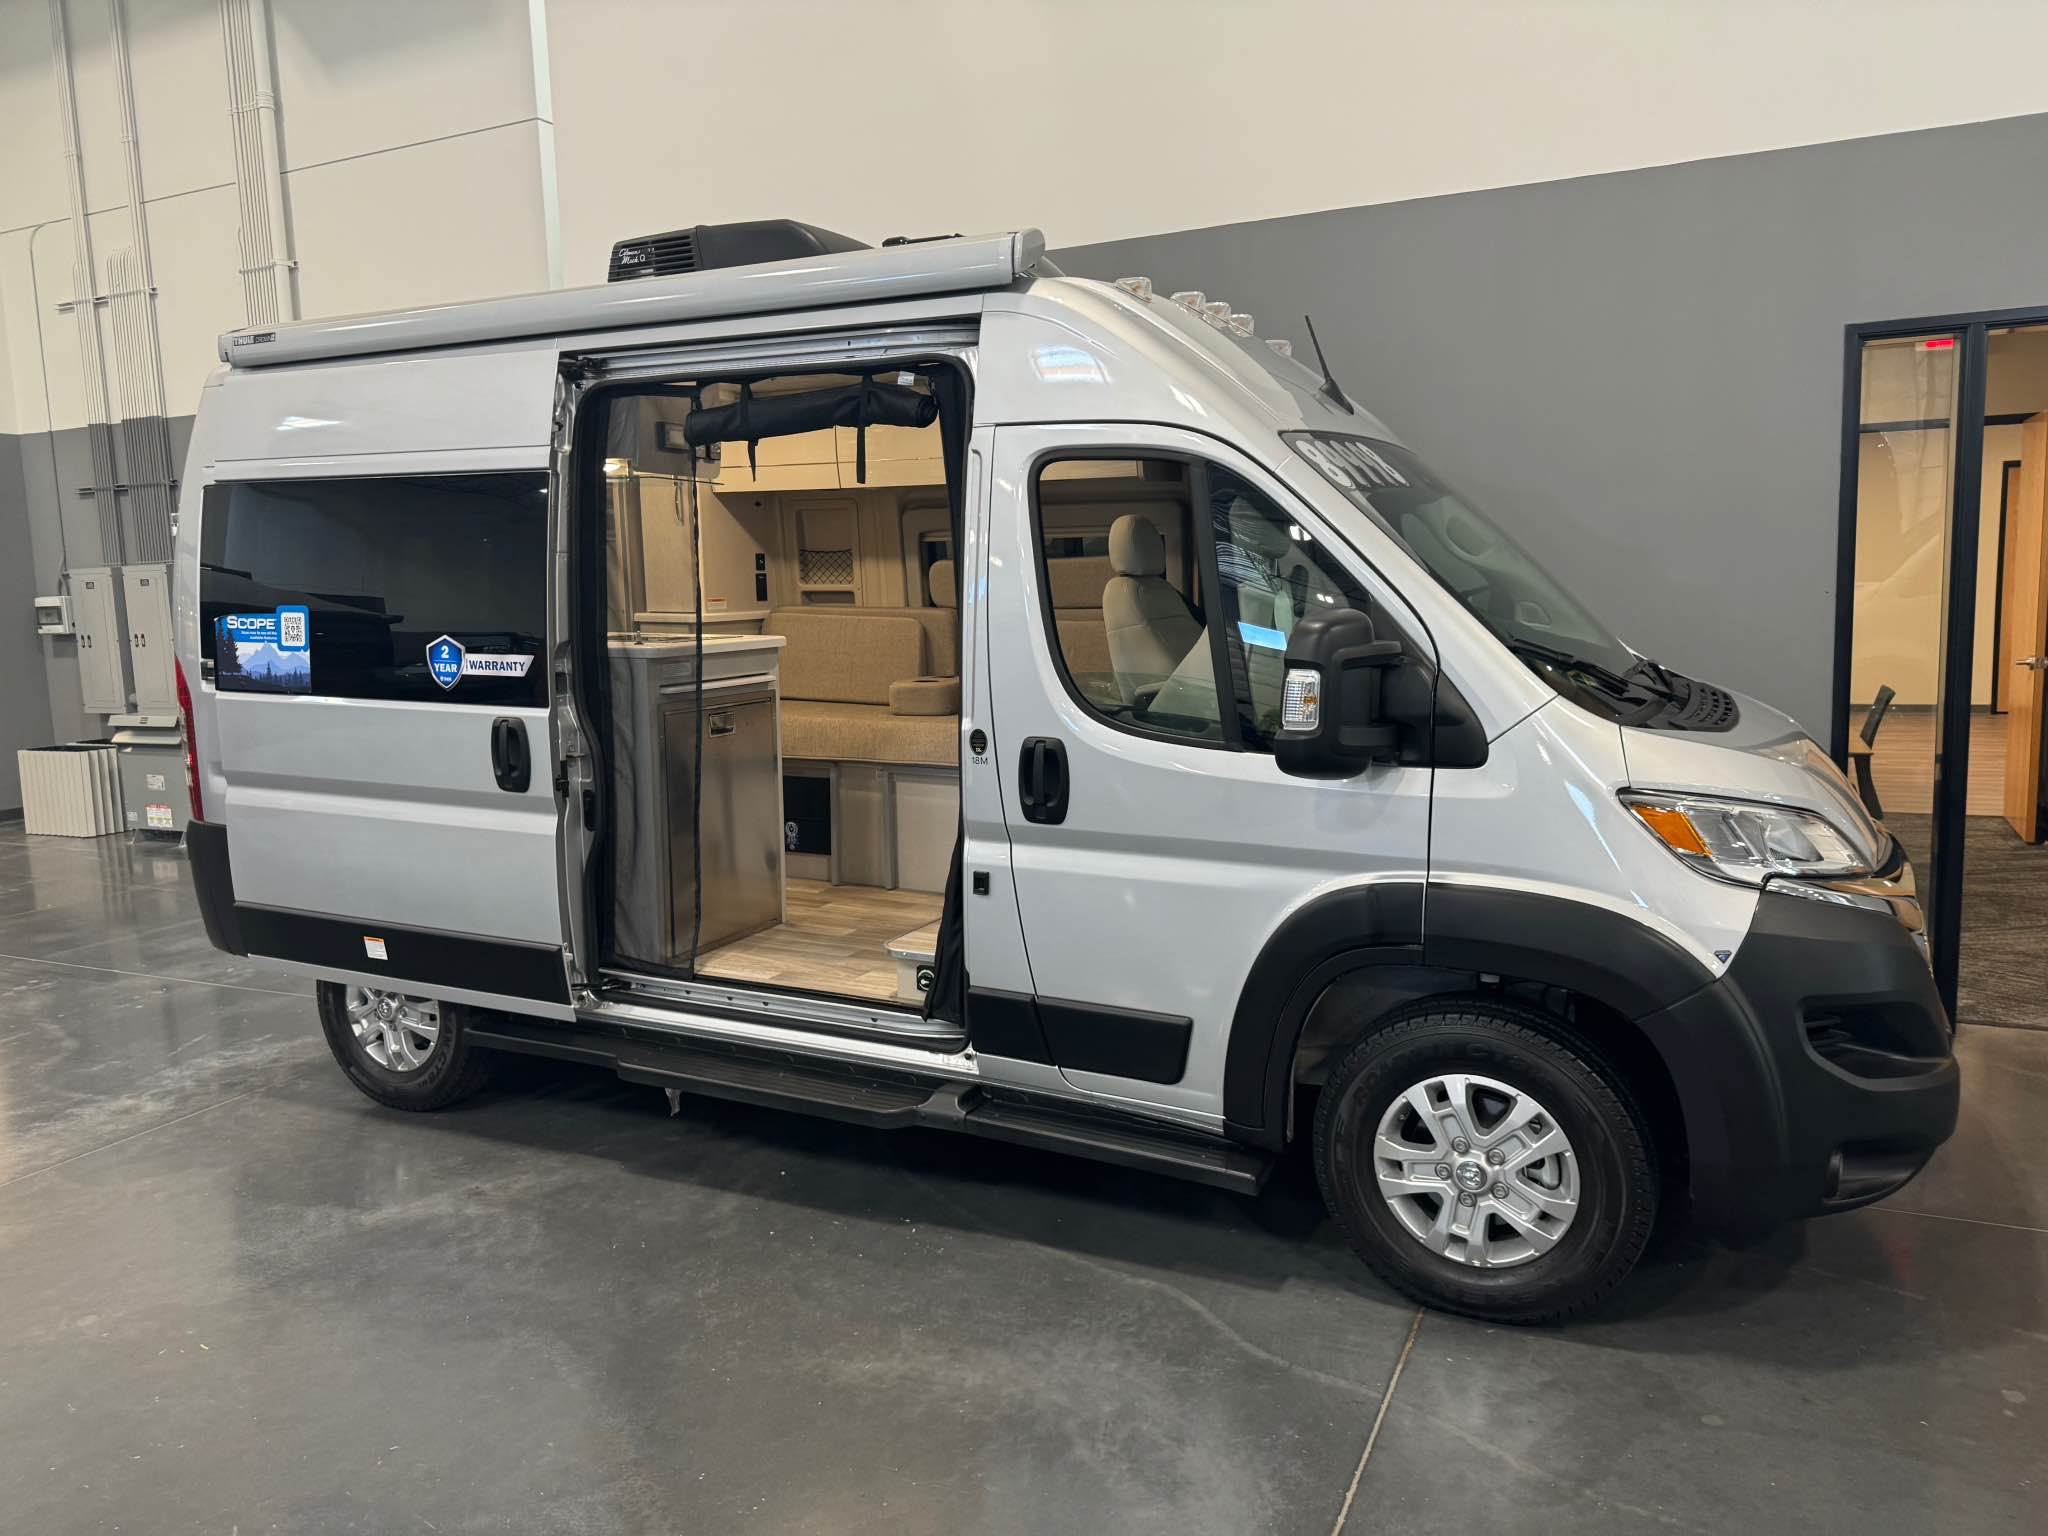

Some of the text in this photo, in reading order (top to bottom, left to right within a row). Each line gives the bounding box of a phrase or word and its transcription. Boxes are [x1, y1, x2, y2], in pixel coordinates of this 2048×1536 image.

[226, 615, 277, 630] SCOPE
[441, 645, 449, 659] 2
[434, 663, 457, 672] YEAR
[469, 659, 525, 672] WARRANTY
